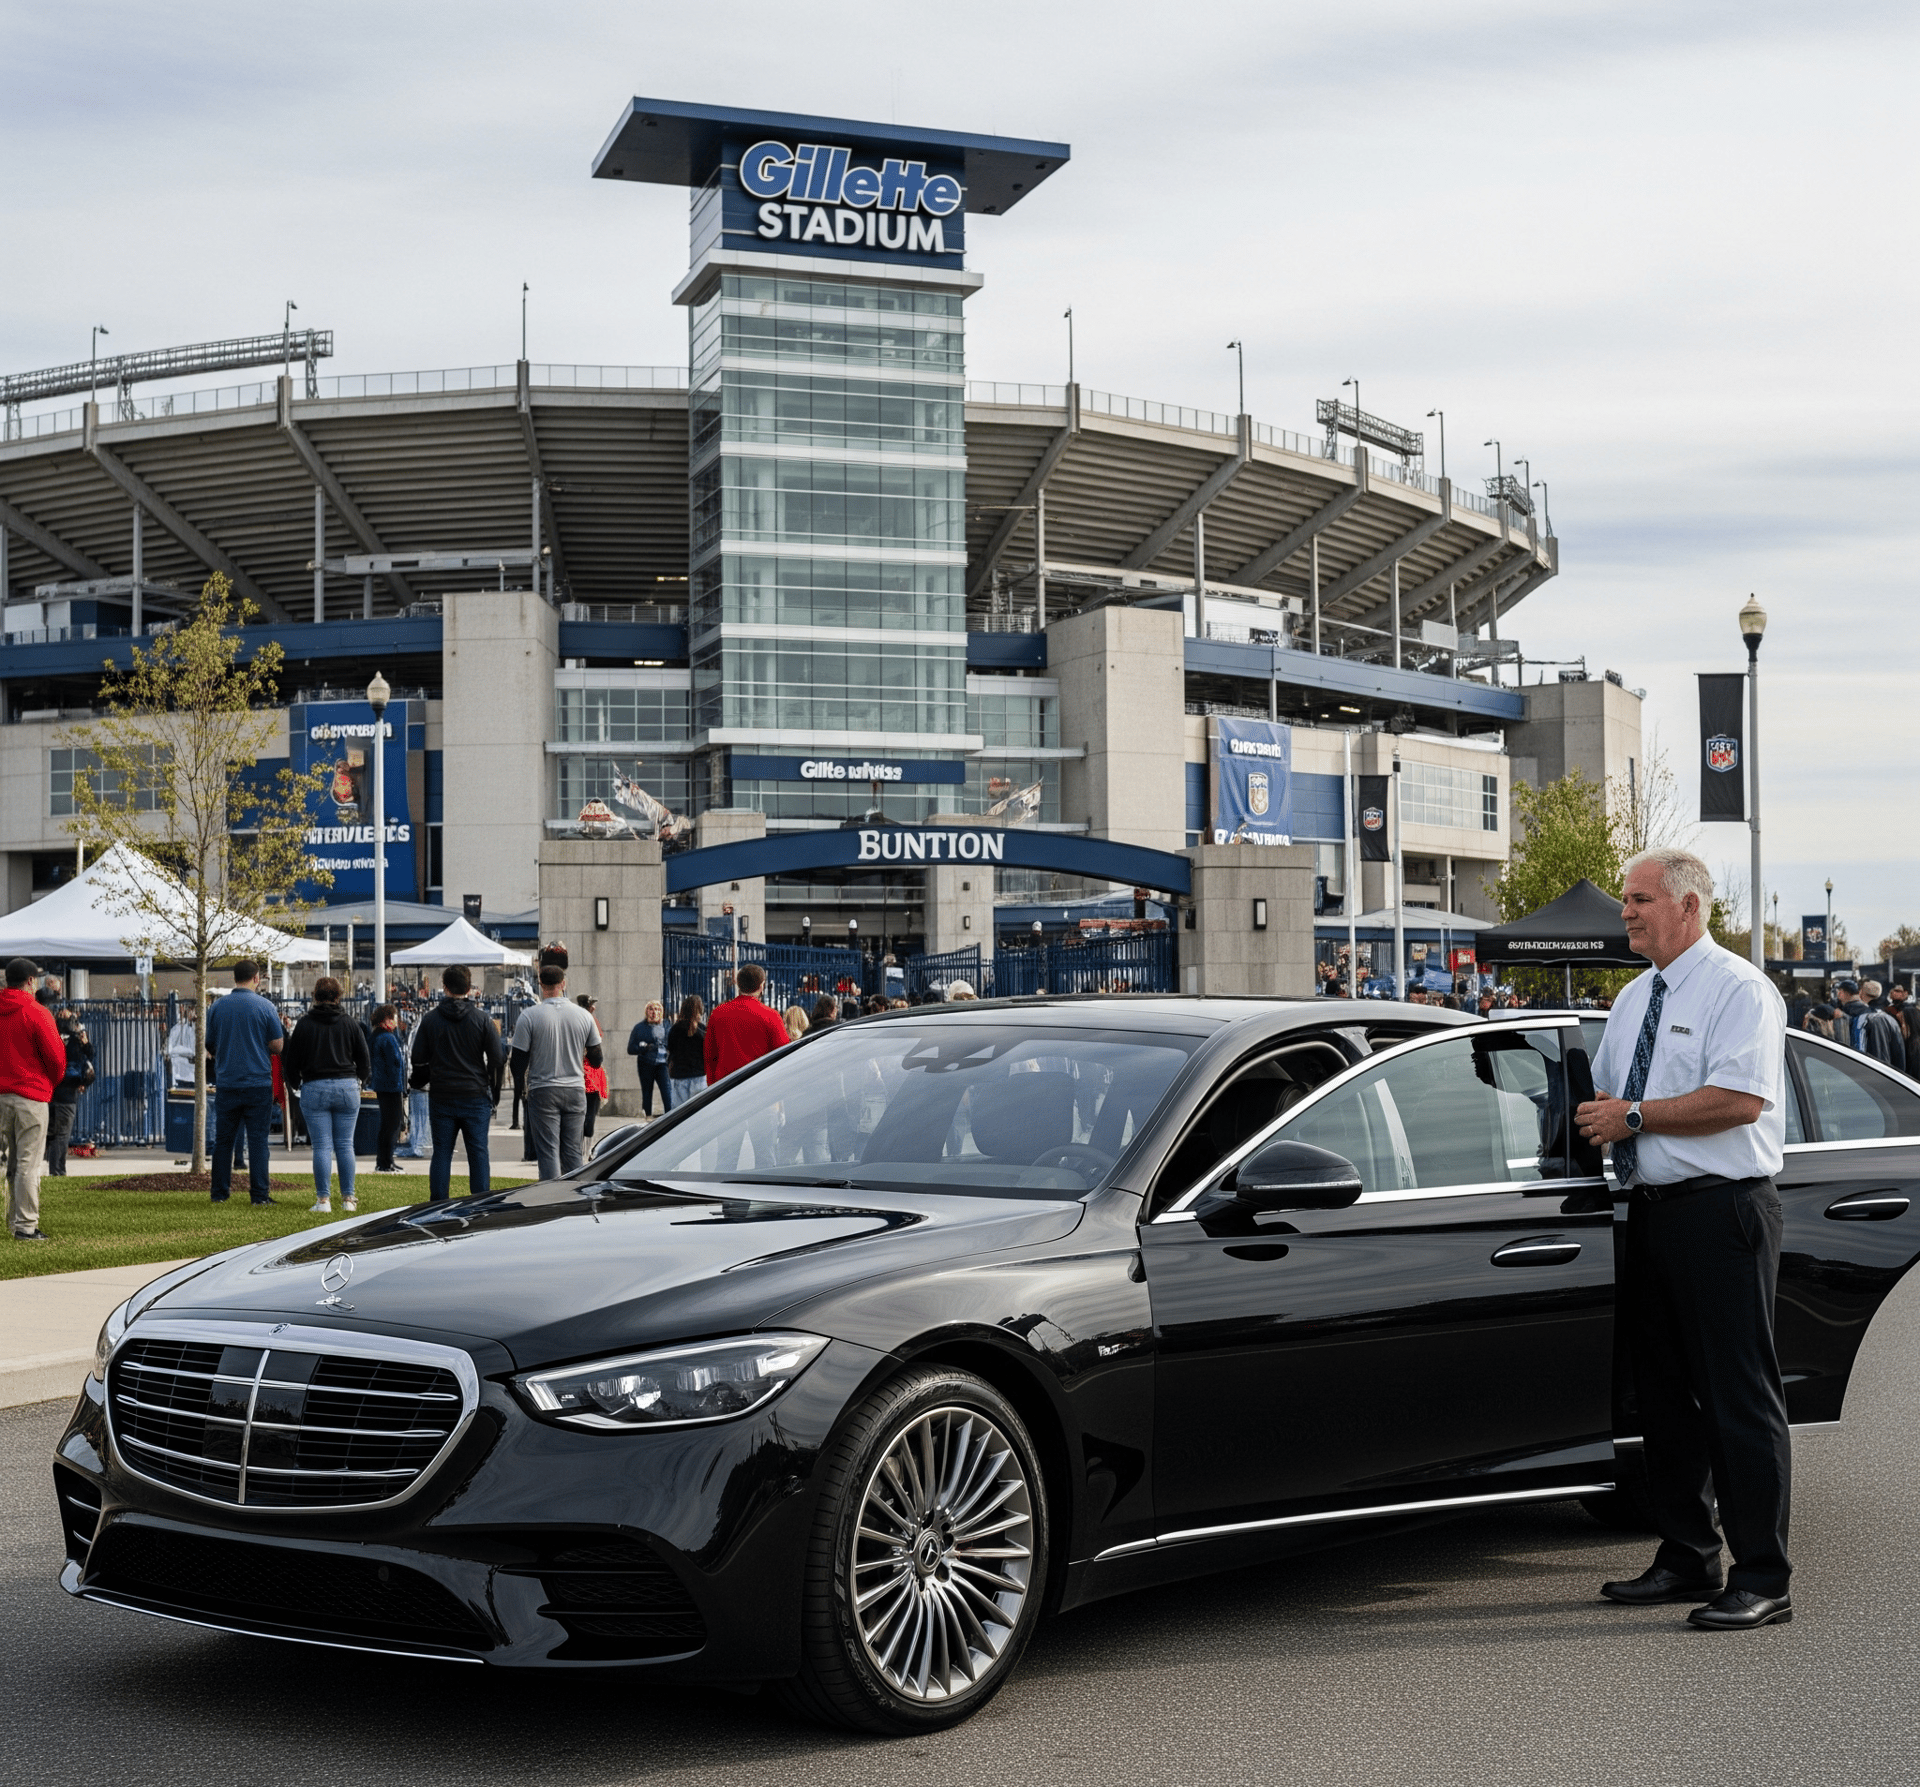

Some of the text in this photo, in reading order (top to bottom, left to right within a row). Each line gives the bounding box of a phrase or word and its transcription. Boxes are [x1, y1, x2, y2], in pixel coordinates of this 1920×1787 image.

[739, 140, 962, 216] Gillette
[757, 202, 945, 253] STADIUM
[857, 829, 1005, 860] BUNTION
